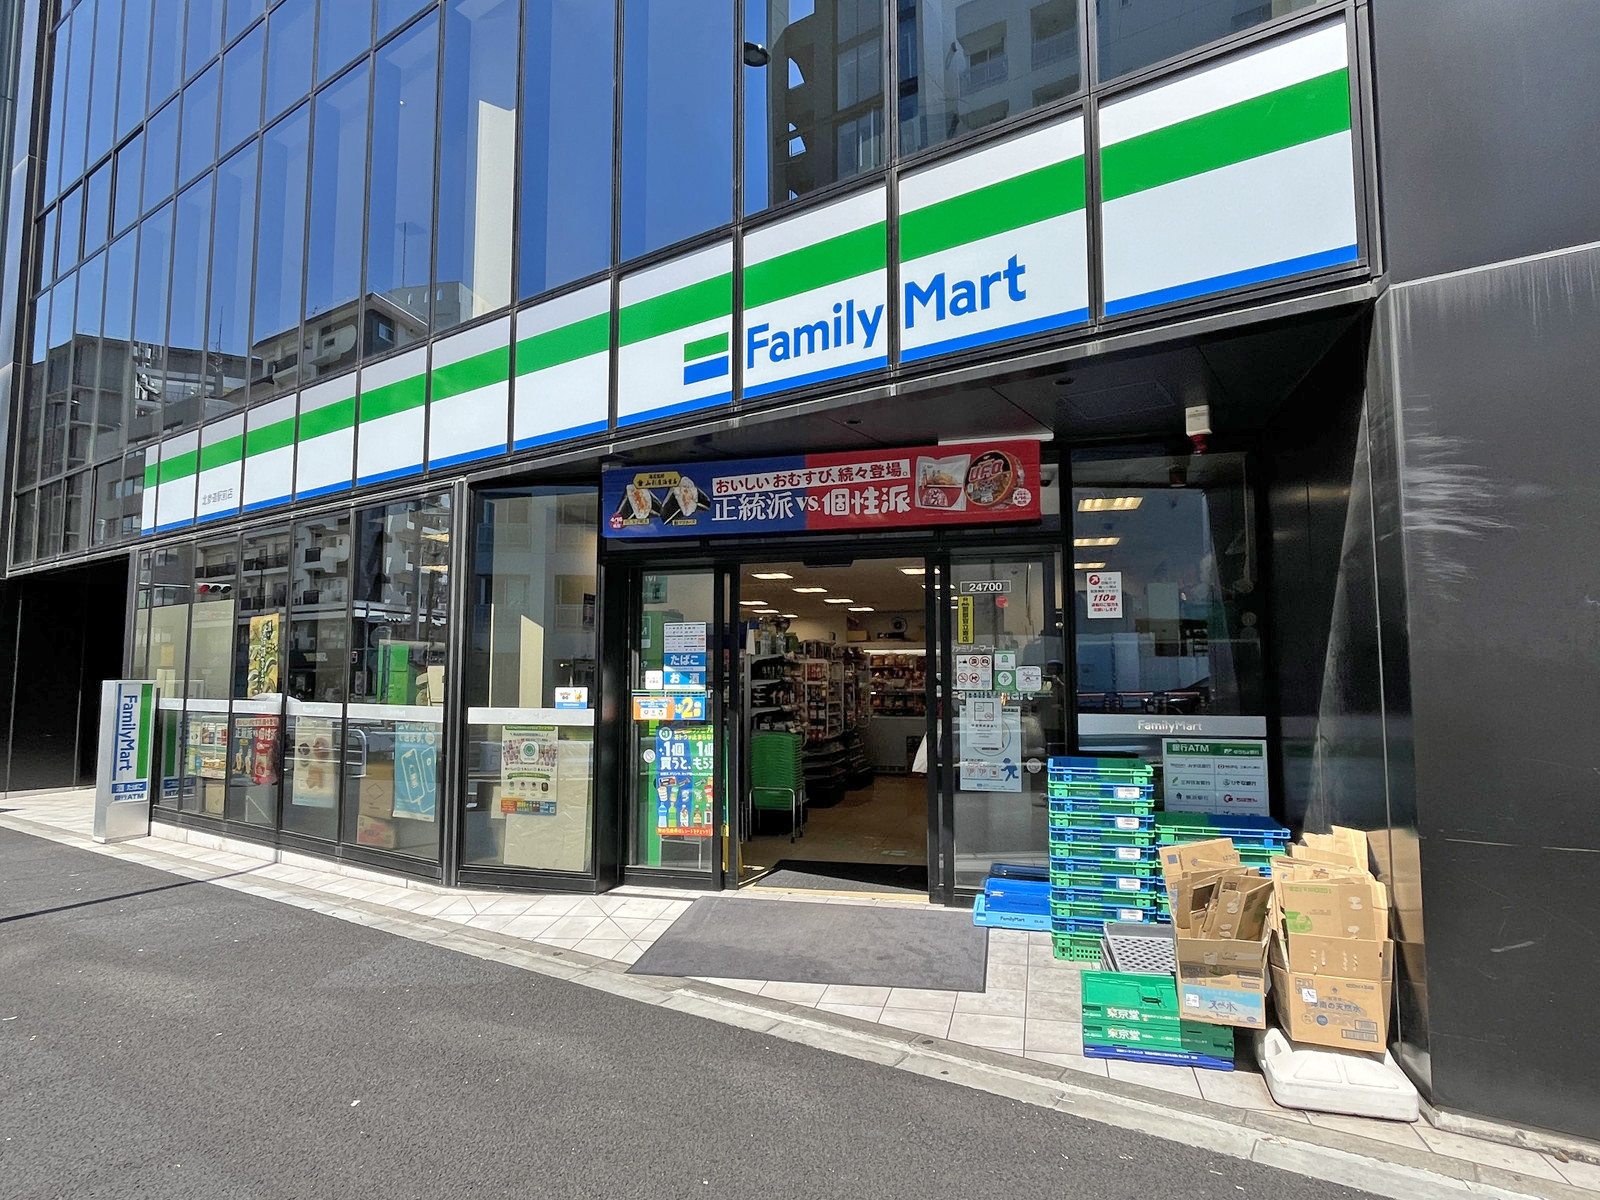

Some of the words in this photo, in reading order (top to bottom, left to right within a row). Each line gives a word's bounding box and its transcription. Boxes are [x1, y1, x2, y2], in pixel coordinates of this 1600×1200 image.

[715, 477, 770, 494] おいしい
[773, 461, 909, 488] おむすび、続々登場。
[711, 491, 794, 521] 正統派
[822, 484, 911, 516] 個性派
[968, 582, 1003, 592] 24700
[670, 654, 700, 666] たばこ
[1137, 720, 1202, 733] FamilyMart
[118, 695, 139, 772] FamilyMart
[1171, 744, 1210, 753] 銀行ATM
[1000, 915, 1026, 923] FamilyMart
